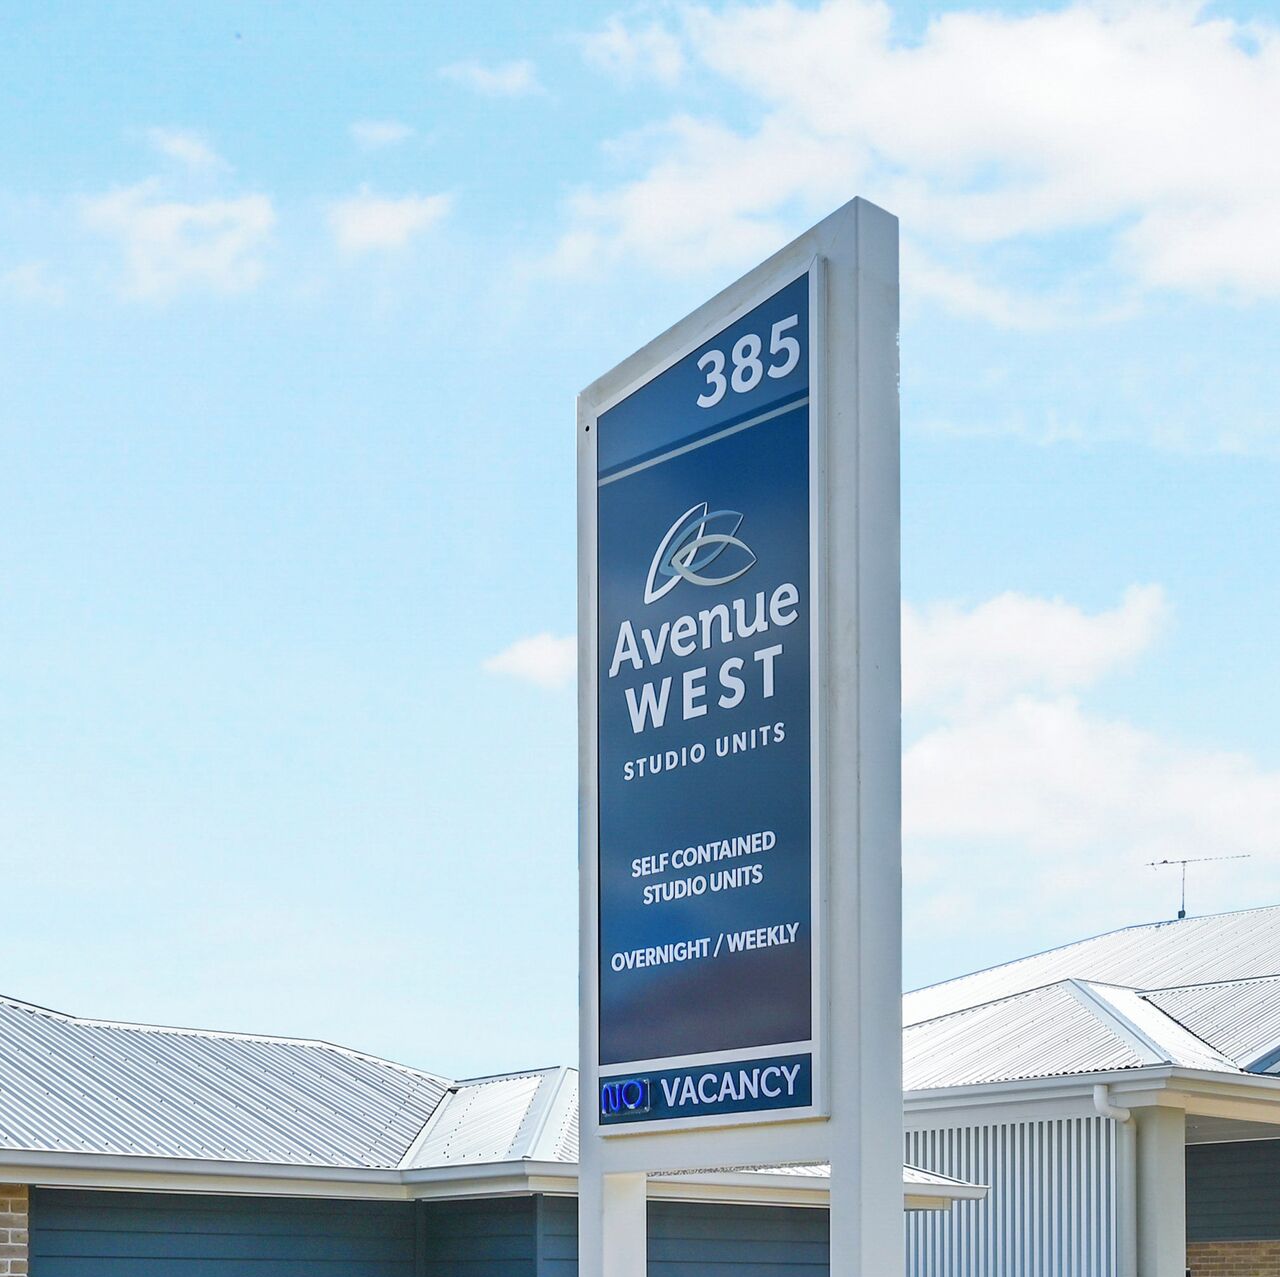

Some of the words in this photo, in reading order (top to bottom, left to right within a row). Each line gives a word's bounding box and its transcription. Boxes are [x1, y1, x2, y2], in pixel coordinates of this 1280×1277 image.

[696, 313, 801, 409] 385
[608, 582, 800, 679] Avenue
[624, 644, 784, 735] WEST
[623, 743, 707, 782] STUDIO
[716, 722, 787, 758] UNITS
[631, 852, 670, 879] SELF
[671, 830, 777, 870] CONTAINED
[642, 874, 708, 906] STUDIO
[709, 863, 764, 892] UNITS
[610, 936, 711, 973] OVERNIGHT
[726, 922, 801, 954] WEEKLY
[602, 1080, 644, 1114] NO
[660, 1063, 802, 1108] VACANCY
